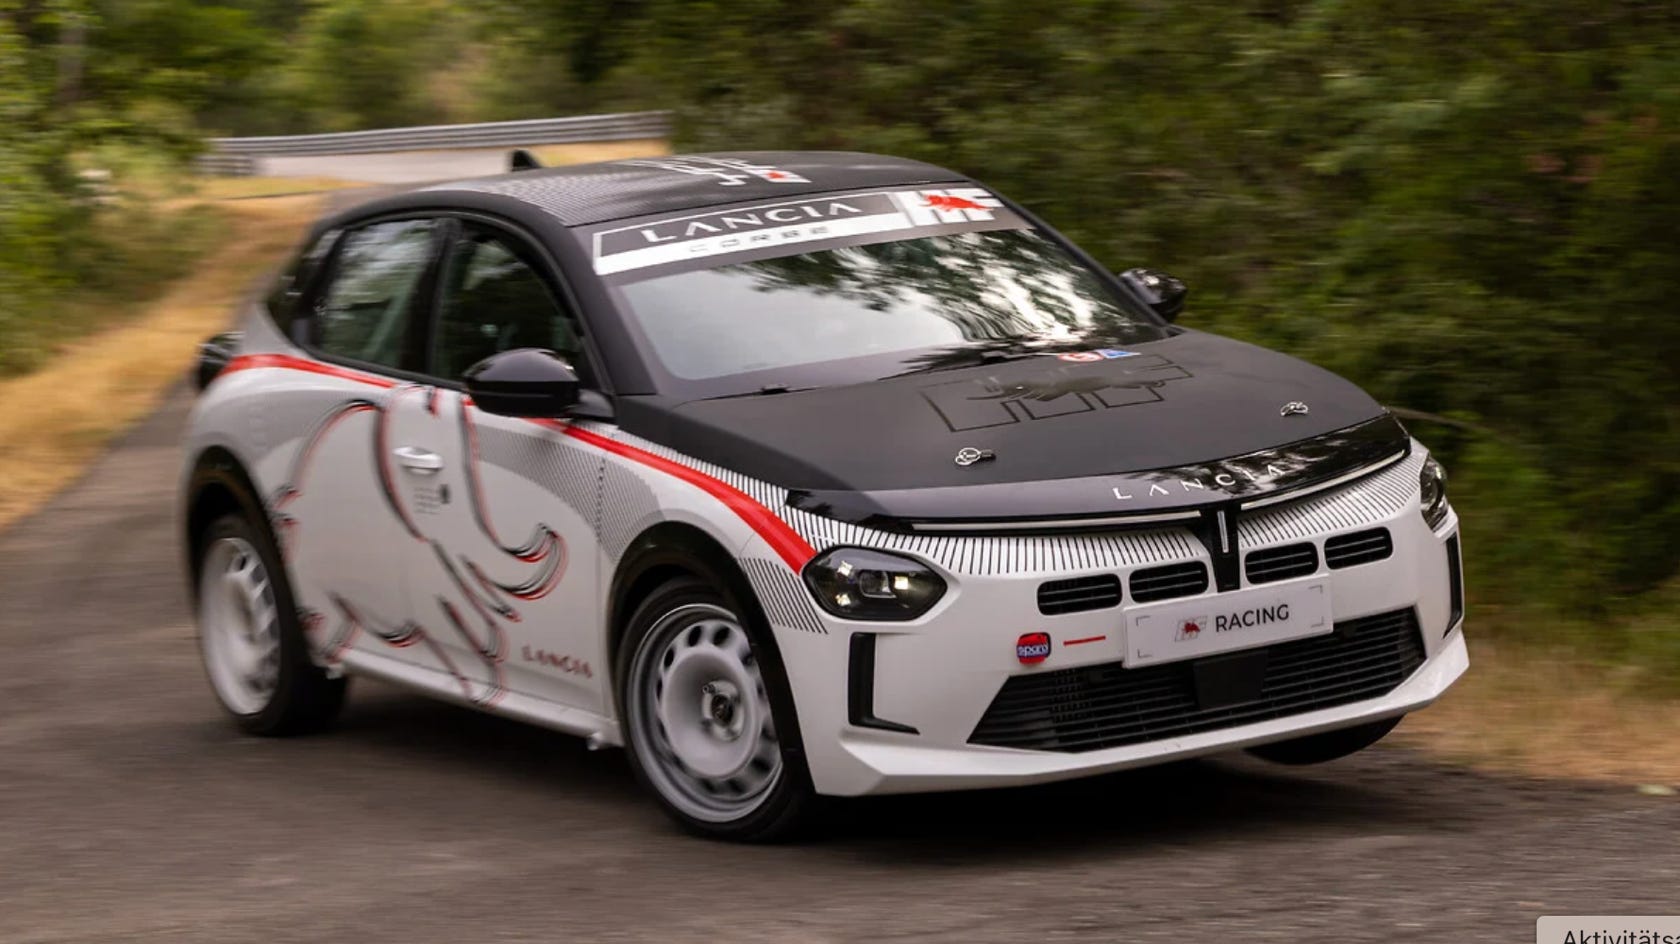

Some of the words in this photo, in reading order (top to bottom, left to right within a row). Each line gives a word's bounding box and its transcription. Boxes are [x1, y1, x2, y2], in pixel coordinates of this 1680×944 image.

[641, 203, 862, 242] LANCIA
[1112, 463, 1286, 500] LANCIA
[1215, 604, 1289, 633] RACING
[521, 644, 593, 678] LANCIA
